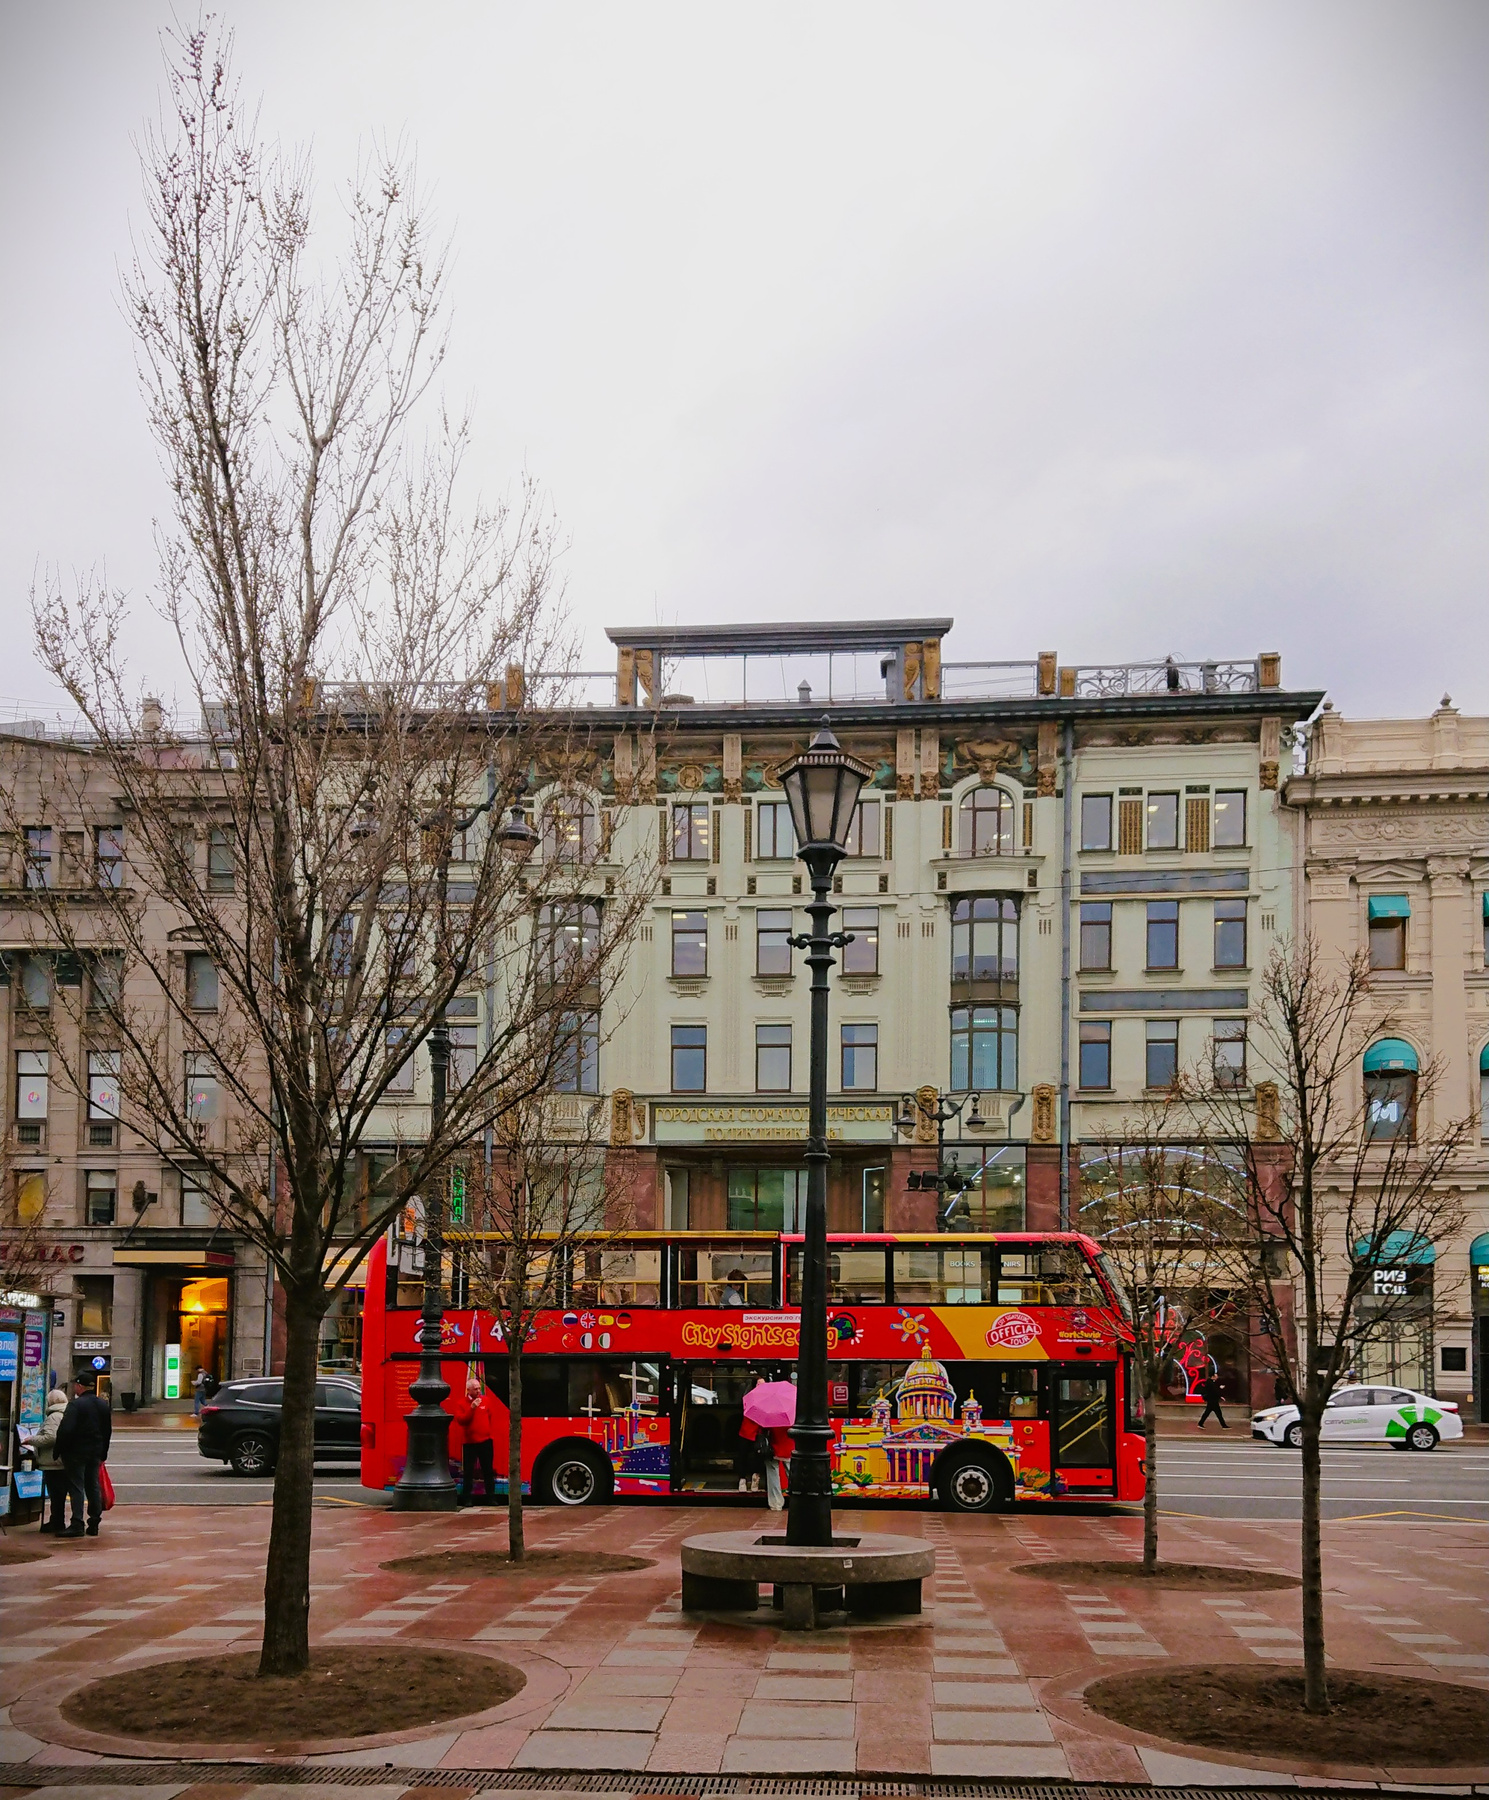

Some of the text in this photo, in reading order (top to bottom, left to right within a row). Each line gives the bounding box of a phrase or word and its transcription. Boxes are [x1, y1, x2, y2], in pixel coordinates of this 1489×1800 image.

[655, 1107, 892, 1122] ГОРОДСКАЯ СТОМАТОЛИЧЕСКАЯ
[682, 1321, 721, 1349] City
[990, 1324, 1039, 1343] OFFICIAL
[1010, 1335, 1031, 1346] TOUR
[74, 1341, 110, 1350] СЕВЕР
